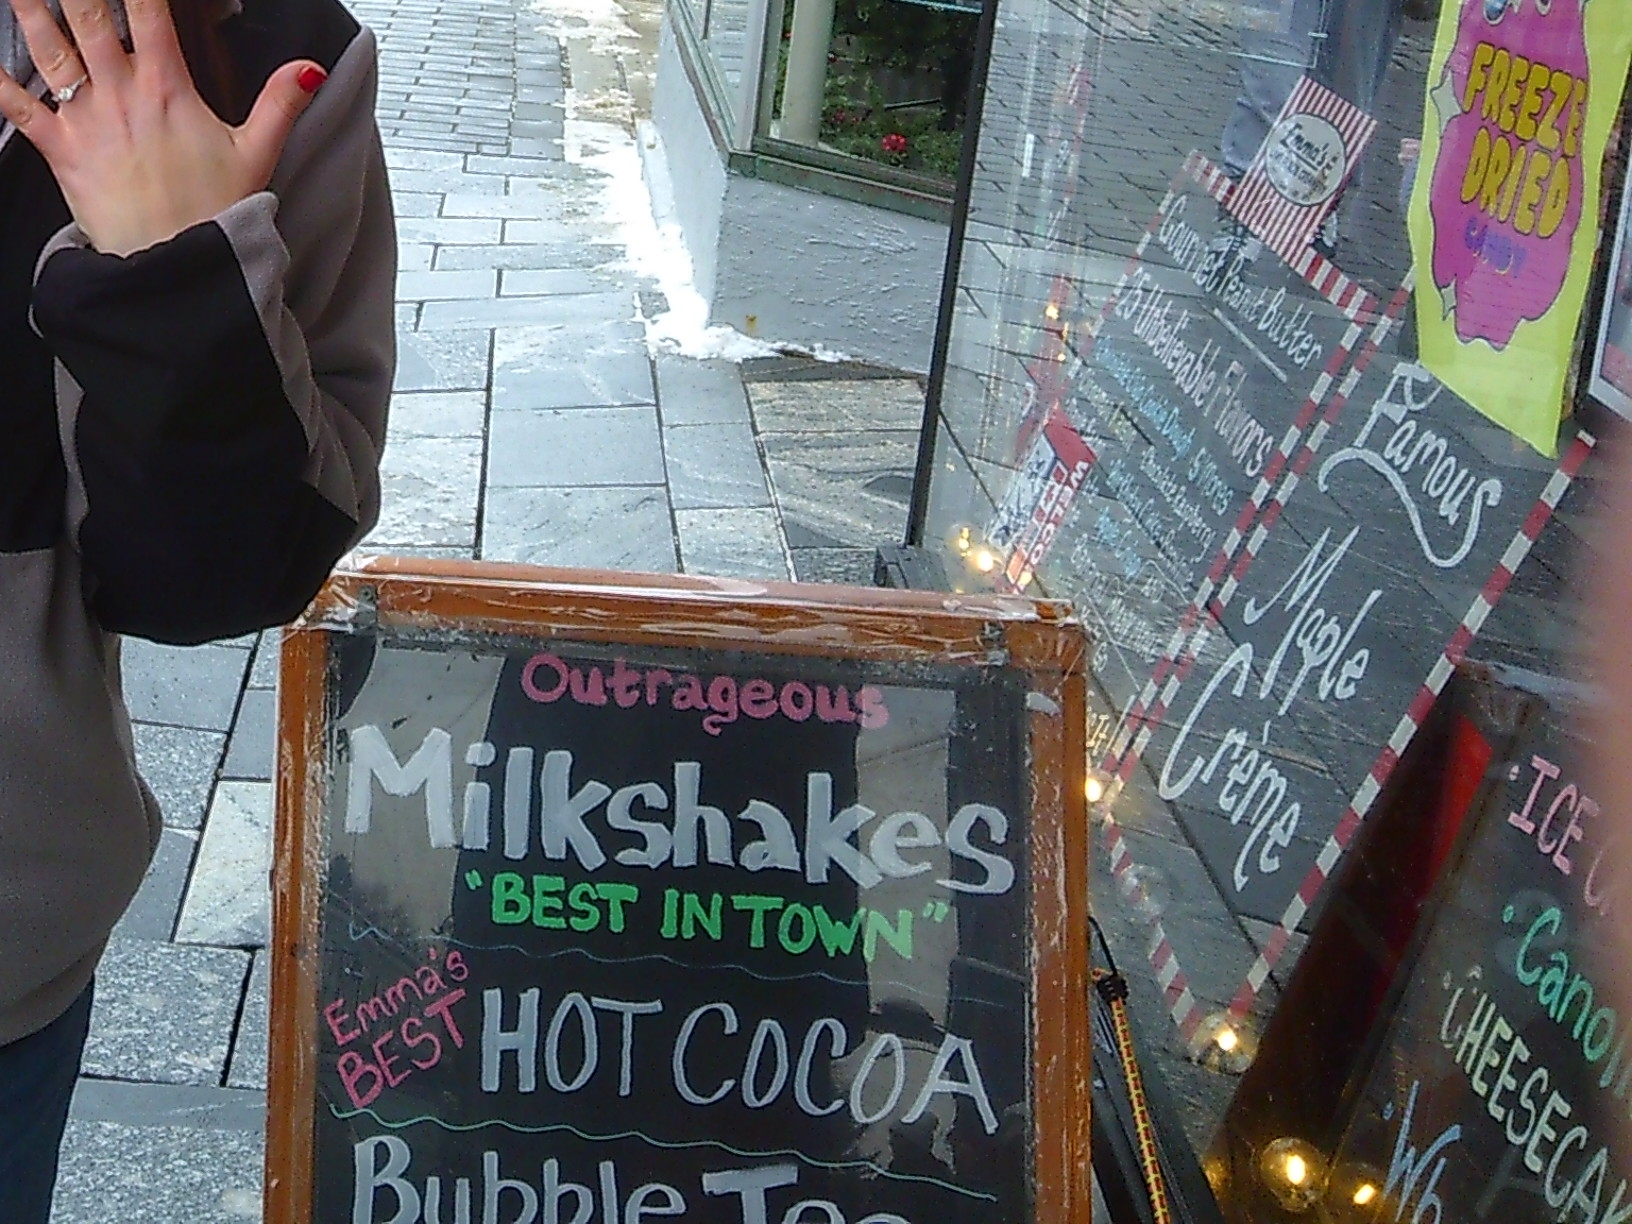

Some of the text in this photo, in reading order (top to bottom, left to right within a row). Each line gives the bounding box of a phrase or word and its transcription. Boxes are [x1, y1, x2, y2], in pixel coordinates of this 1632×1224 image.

[1462, 41, 1587, 157] FREEZE
[1460, 126, 1570, 238] DRIED
[1258, 286, 1322, 371] Butter
[1204, 359, 1273, 477] Flavors
[1319, 362, 1503, 569] Famous
[1243, 526, 1382, 716] Maple
[520, 652, 889, 736] Outrageous
[344, 724, 1017, 895] Milkshakes
[1508, 754, 1600, 875] ICE
[660, 891, 724, 941] IN
[324, 947, 470, 1049] Emma's
[336, 988, 467, 1110] BEST
[481, 986, 999, 1136] HOT COCOA
[352, 1134, 688, 1224] Bubble
